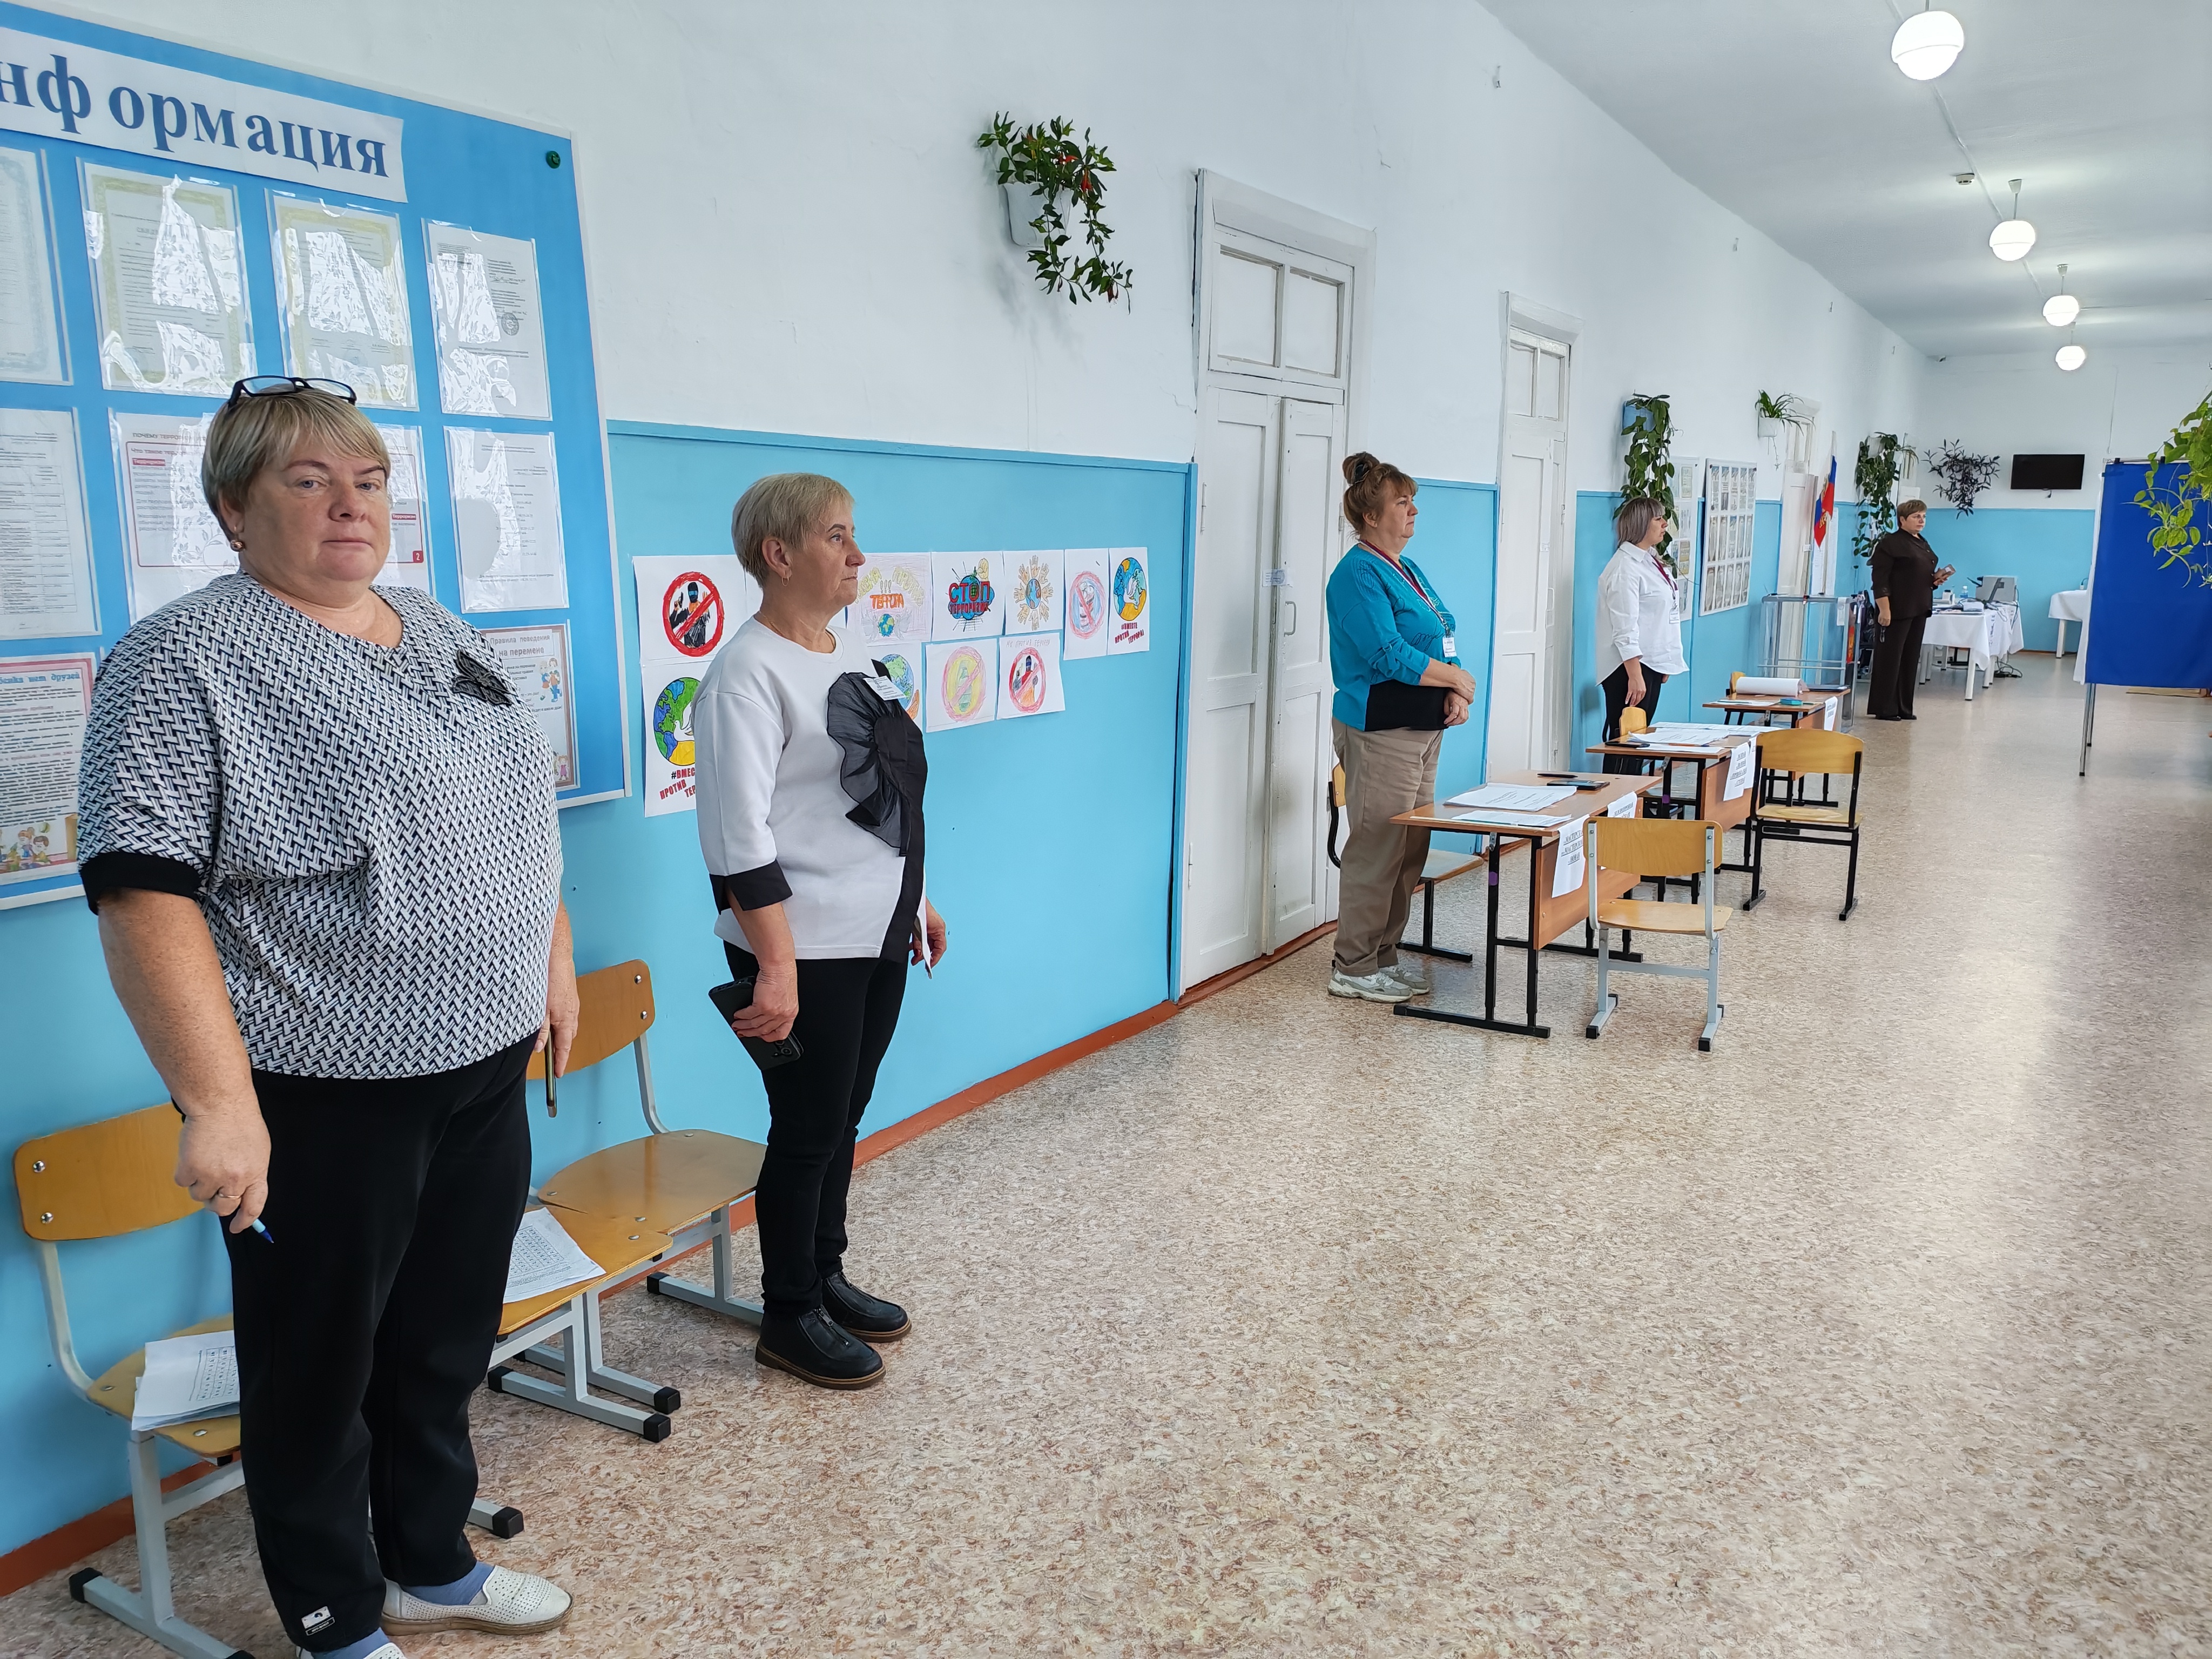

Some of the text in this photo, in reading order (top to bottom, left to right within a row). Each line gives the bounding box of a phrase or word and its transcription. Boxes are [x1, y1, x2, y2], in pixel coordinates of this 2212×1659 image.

[416, 552, 420, 561] 2
[949, 581, 990, 603] СТОП
[490, 635, 550, 646] Правила поведения
[1115, 630, 1129, 644] ПРОТИВ
[510, 647, 544, 656] перемене
[671, 767, 696, 779] #ВМЕС
[659, 779, 687, 800] ПРОТИВ
